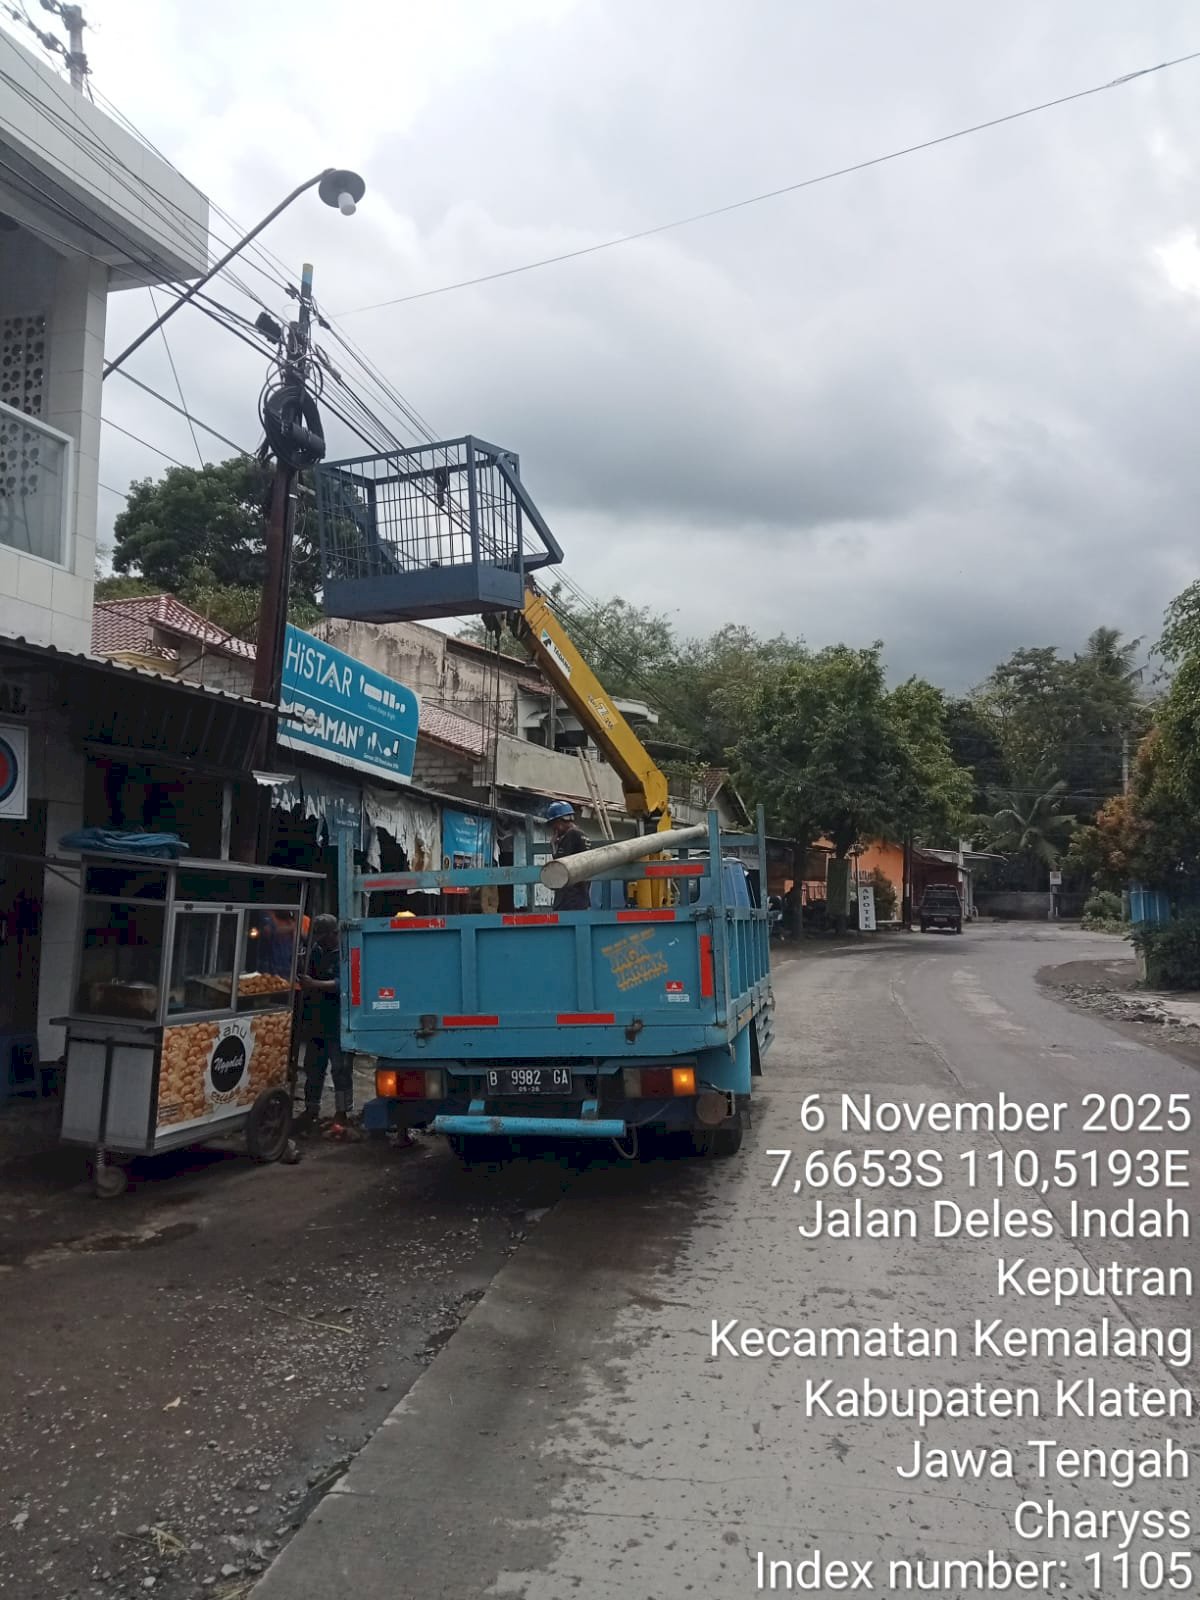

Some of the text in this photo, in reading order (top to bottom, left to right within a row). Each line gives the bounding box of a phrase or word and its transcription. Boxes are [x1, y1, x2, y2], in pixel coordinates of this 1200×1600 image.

[285, 638, 352, 697] HiSTAR
[862, 888, 873, 929] APOTEK
[489, 1069, 569, 1086] B 9982 GA
